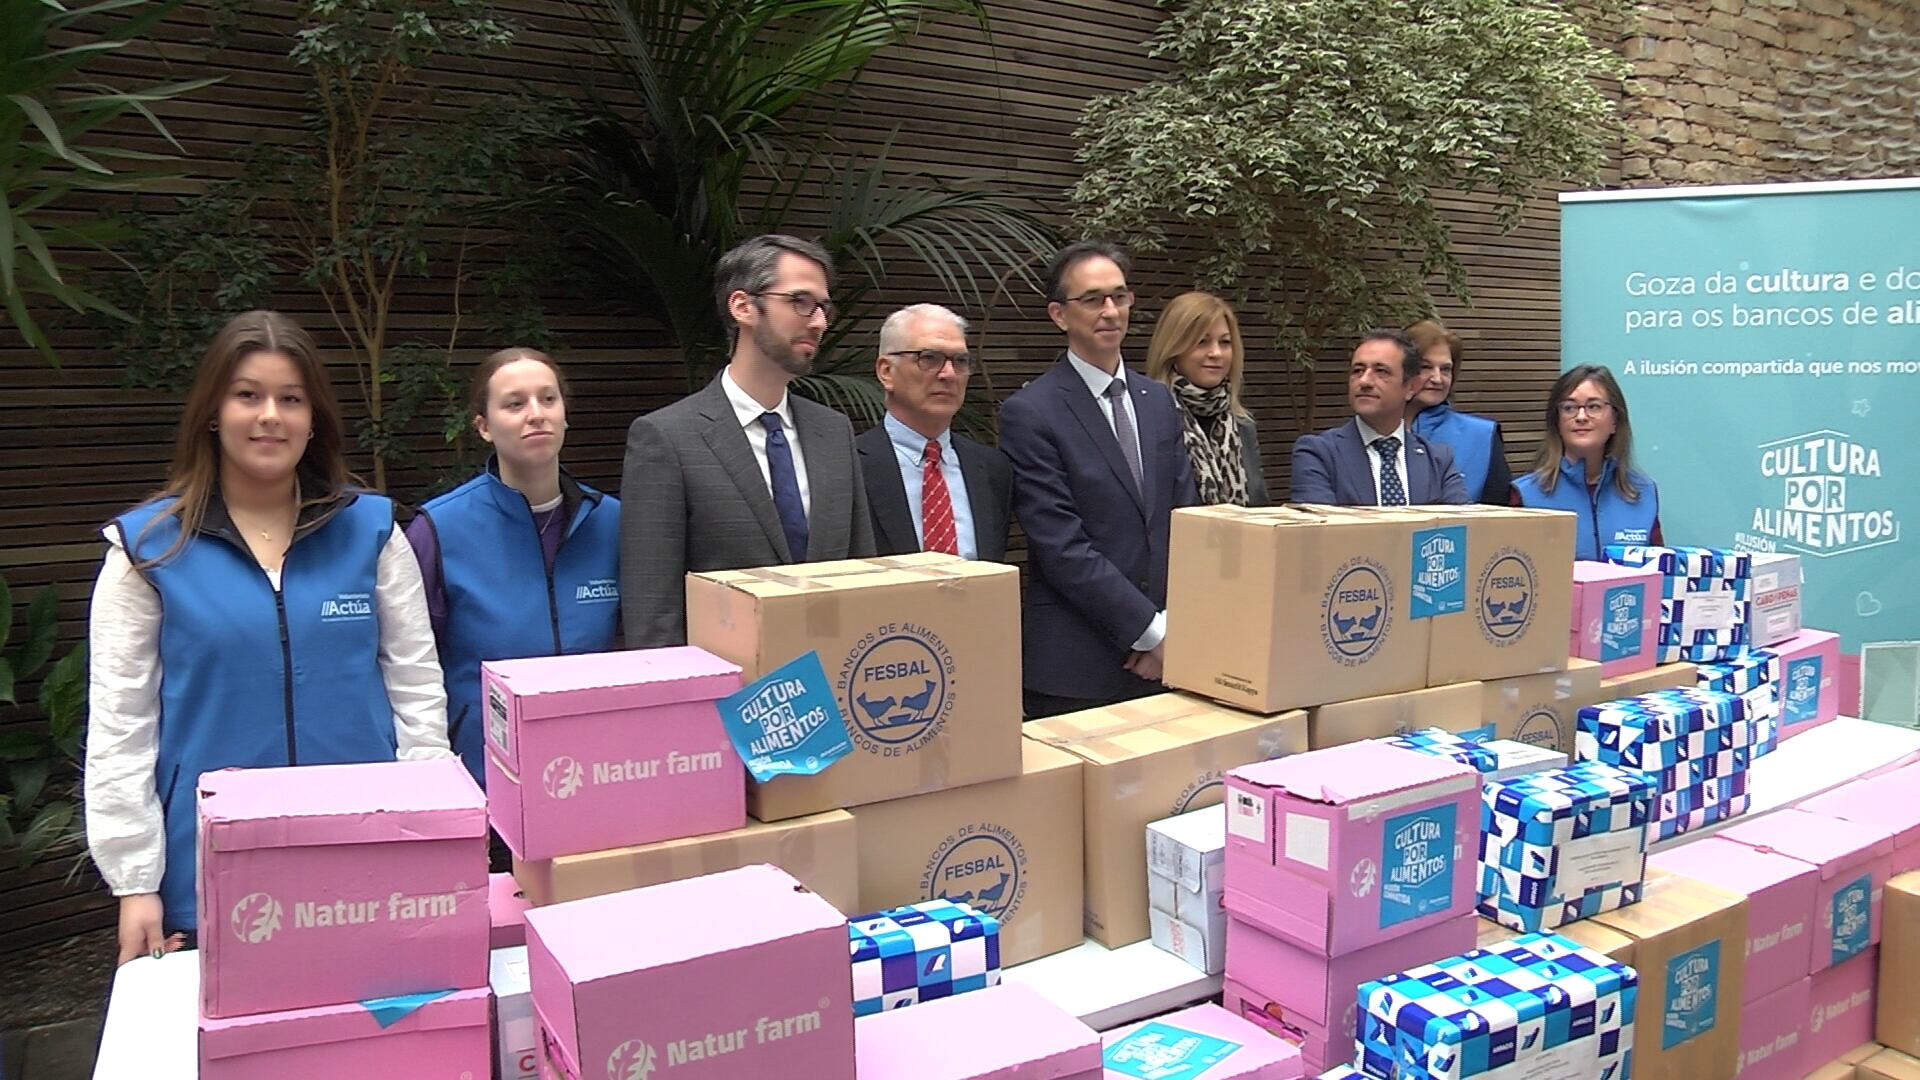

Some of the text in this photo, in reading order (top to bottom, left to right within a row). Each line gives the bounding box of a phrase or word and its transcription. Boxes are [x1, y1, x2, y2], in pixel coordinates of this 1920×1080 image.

[1626, 272, 1696, 296] Goza
[1704, 270, 1737, 294] da
[1746, 268, 1849, 293] cultura
[1859, 272, 1877, 291] e
[1626, 308, 1682, 334] para
[1692, 308, 1723, 327] os
[1732, 303, 1833, 327] bancos
[1842, 301, 1878, 325] de
[1624, 360, 1637, 375] A
[1640, 359, 1698, 375] ilusión
[1701, 358, 1804, 377] compartida
[1808, 360, 1844, 378] que
[1847, 360, 1882, 375] nos
[1761, 438, 1881, 477] CULTURA
[1786, 478, 1844, 511] POR
[1752, 507, 1894, 548] ALIMENTOS
[1420, 537, 1456, 559] CULTURA
[1417, 566, 1460, 588] ALIMENTOS
[1490, 576, 1526, 589] FESBAL
[1339, 588, 1380, 604] FESBAL
[837, 621, 956, 690] BANCOS DE ALIMENTOS
[864, 660, 931, 682] FESBAL
[741, 678, 808, 724] CULTURA
[750, 705, 825, 757] ALIMENTOS
[760, 703, 797, 735] POR
[883, 746, 901, 757] DE
[905, 691, 957, 755] ALIMENTOS
[592, 759, 660, 785] Natur
[667, 751, 722, 774] farm
[1394, 820, 1442, 850] CULTURA
[919, 822, 1028, 890] BANCOS DE ALIMENTOS
[944, 855, 1006, 881] FESBAL
[1391, 854, 1445, 884] ALIMENTOS
[1404, 842, 1428, 866] POR
[294, 892, 457, 929] Natur farm
[667, 1010, 821, 1068] Natur farm
